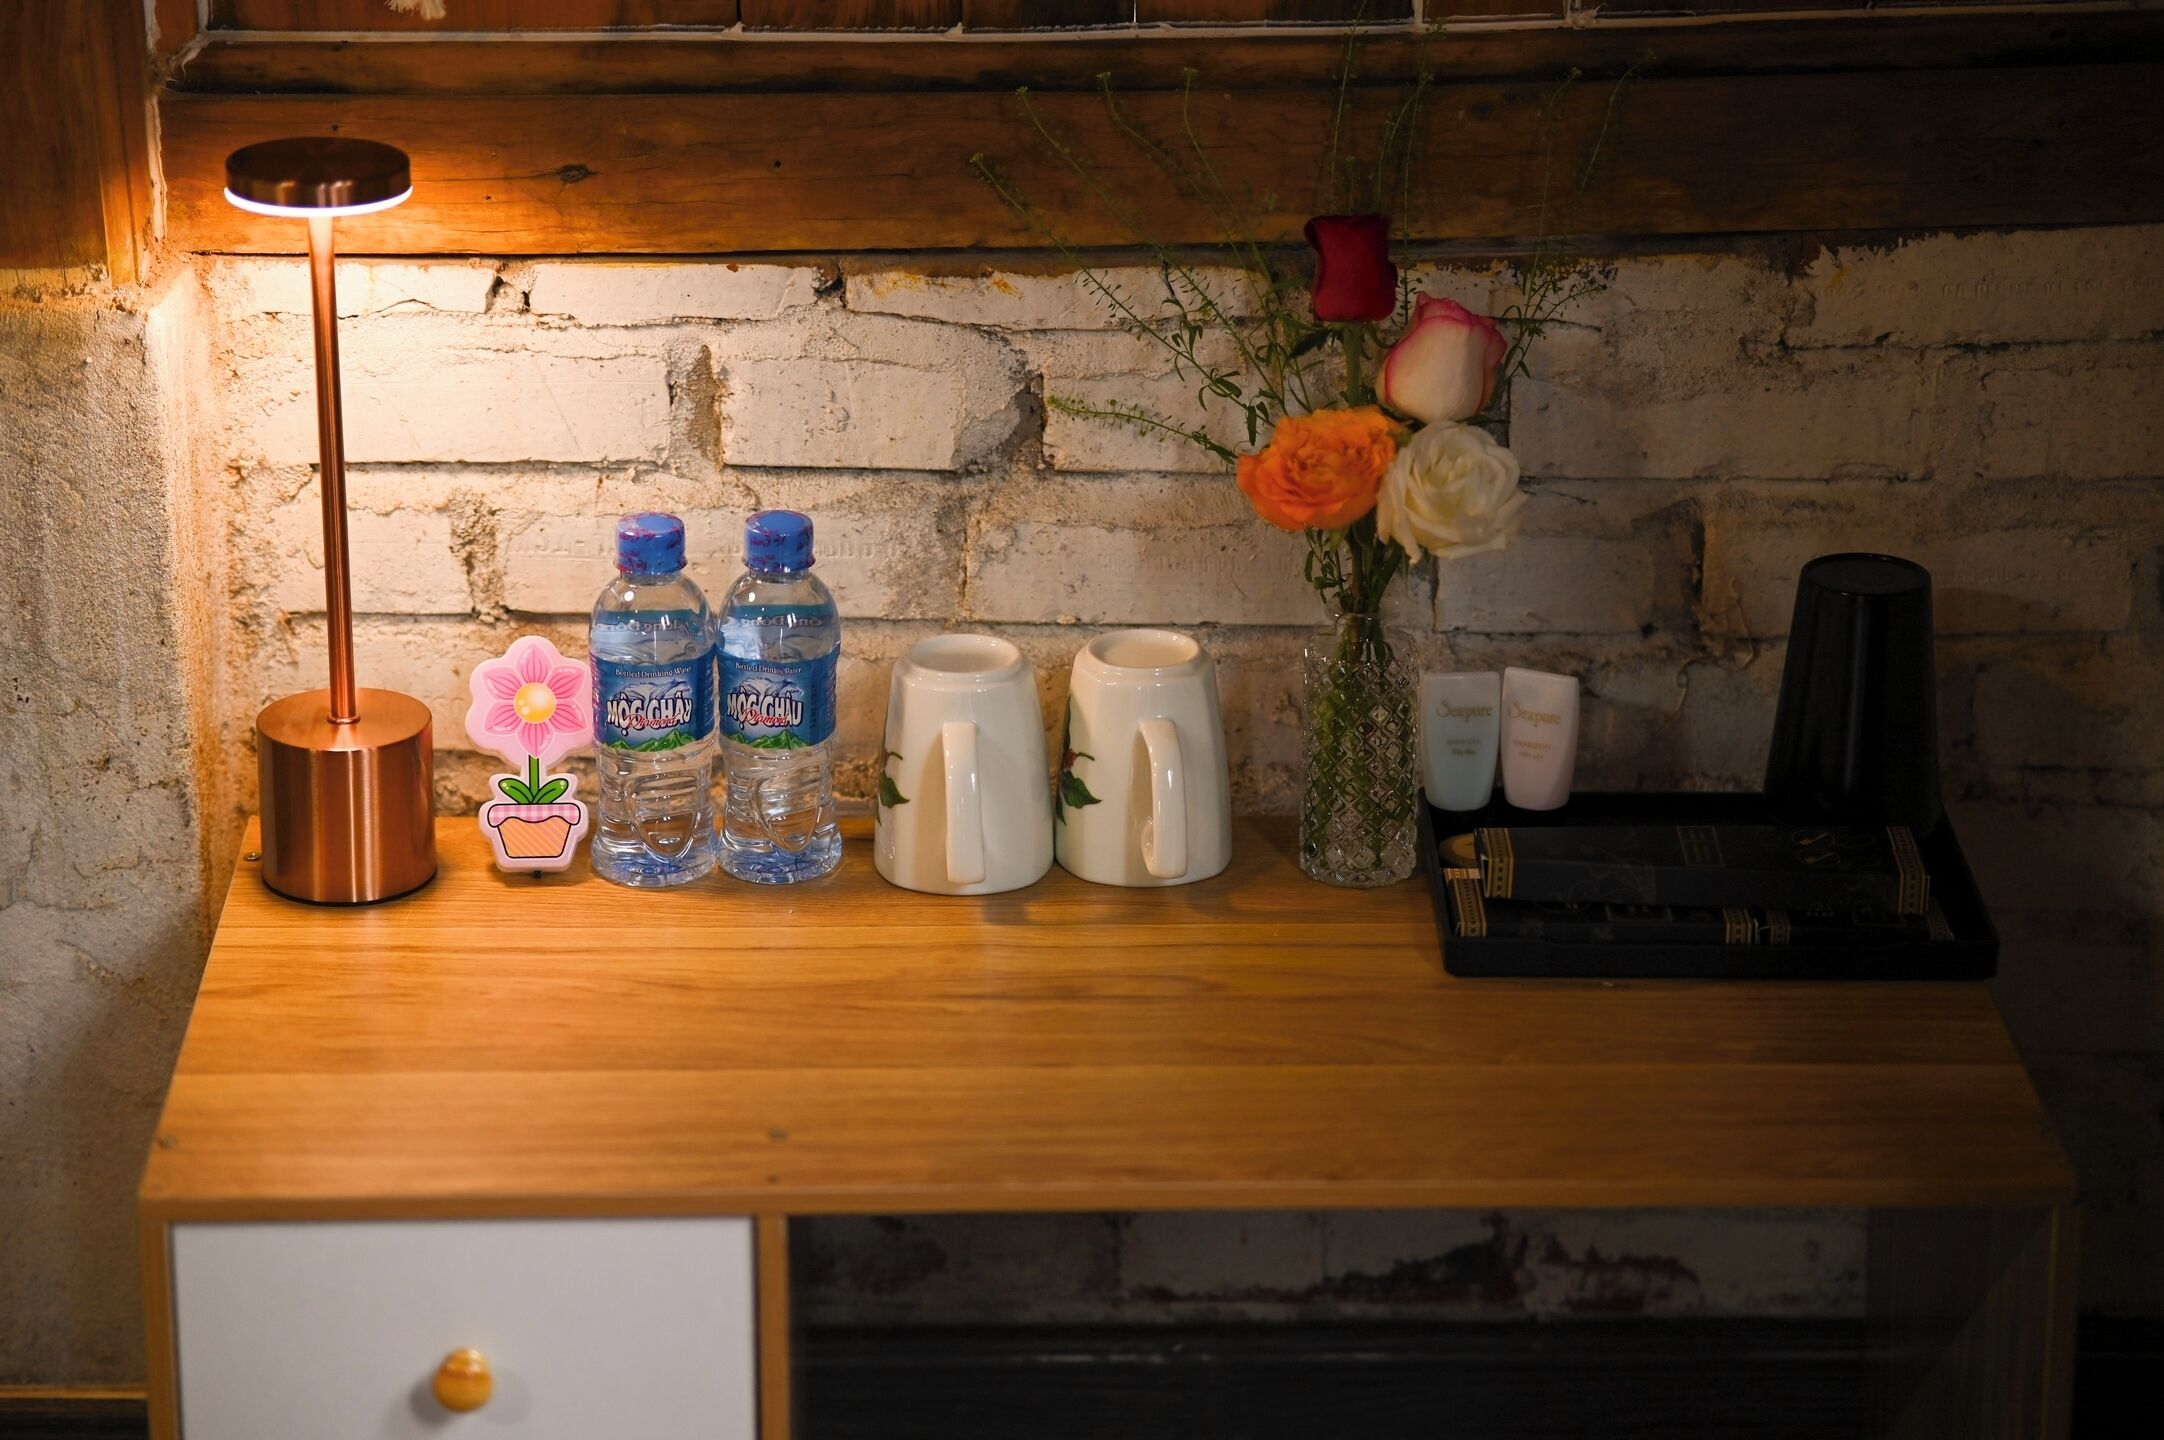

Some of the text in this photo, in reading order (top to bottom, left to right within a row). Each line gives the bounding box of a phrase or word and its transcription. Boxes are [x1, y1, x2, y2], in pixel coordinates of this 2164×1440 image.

[615, 666, 691, 679] Bottled Drinking Water
[735, 662, 758, 673] Bottled
[726, 685, 760, 731] MỘC
[760, 691, 803, 728] CHÂU
[743, 708, 789, 726] Diamond
[1435, 699, 1494, 724] Seapure
[1507, 701, 1562, 728] Seapure
[625, 712, 680, 728] Diamond
